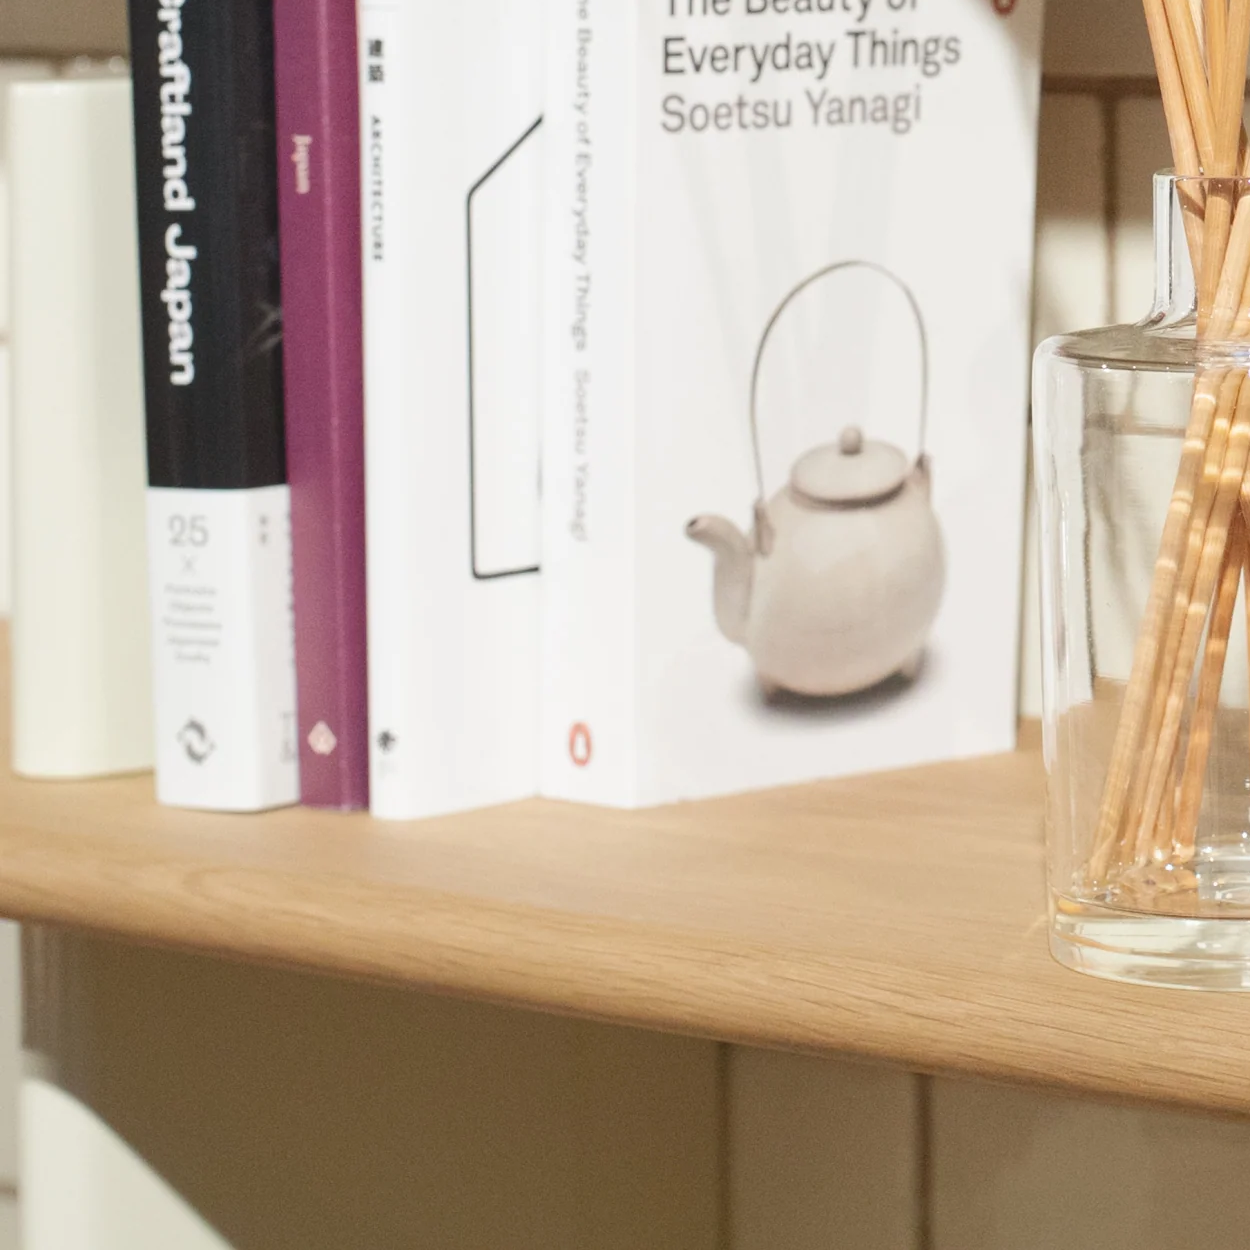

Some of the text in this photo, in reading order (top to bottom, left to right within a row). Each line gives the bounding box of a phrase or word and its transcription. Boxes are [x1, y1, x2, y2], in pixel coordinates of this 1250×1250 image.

[662, 28, 962, 83] Everyday Things
[661, 84, 922, 136] Soetsu Yanagi
[160, 223, 198, 386] Japan
[167, 514, 210, 549] 25
